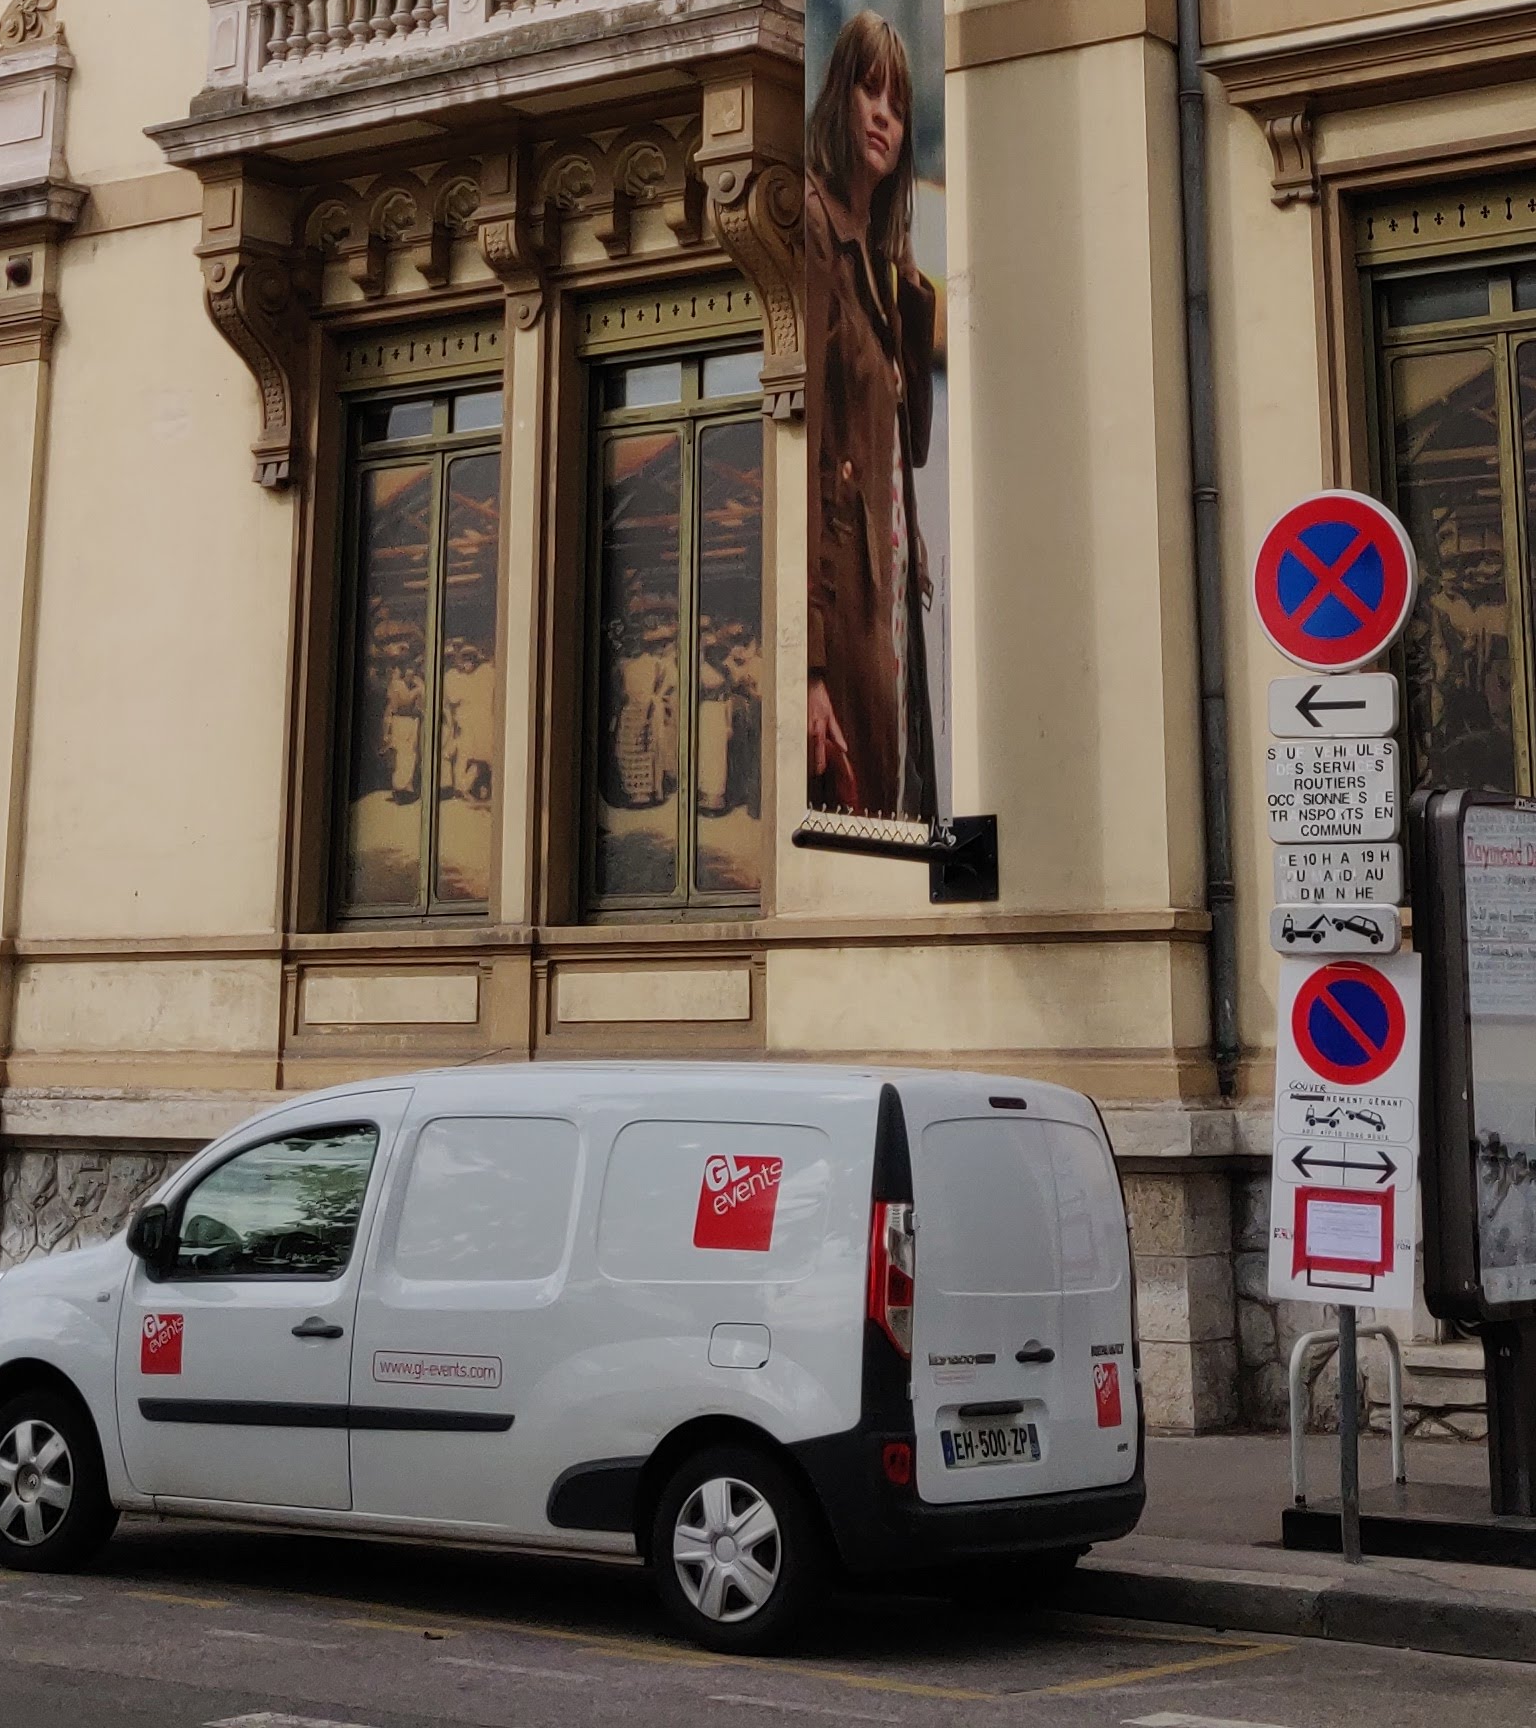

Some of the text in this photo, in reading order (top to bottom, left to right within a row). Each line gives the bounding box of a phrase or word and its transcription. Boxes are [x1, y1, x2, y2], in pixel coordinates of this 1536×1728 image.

[1315, 743, 1392, 758] VHIULS
[1313, 760, 1384, 774] SERVIS
[1294, 776, 1366, 790] ROUTIERS
[1268, 792, 1367, 806] OCCSIONNES
[1270, 807, 1393, 822] TRNSPOTS EN
[1301, 824, 1362, 836] COMMUN
[1303, 853, 1316, 865] 10
[1323, 853, 1331, 865] H
[1341, 852, 1350, 864] A
[1361, 851, 1374, 863] 19
[1381, 850, 1390, 862] H
[1365, 868, 1384, 881] AU
[1369, 1097, 1403, 1108] GÊNANT
[705, 1155, 750, 1191] GL
[714, 1162, 783, 1215] events
[143, 1314, 167, 1338] GL
[148, 1316, 184, 1353] events
[379, 1359, 496, 1380] www.gl-events.com
[954, 1428, 1027, 1460] EH-500-ZP
